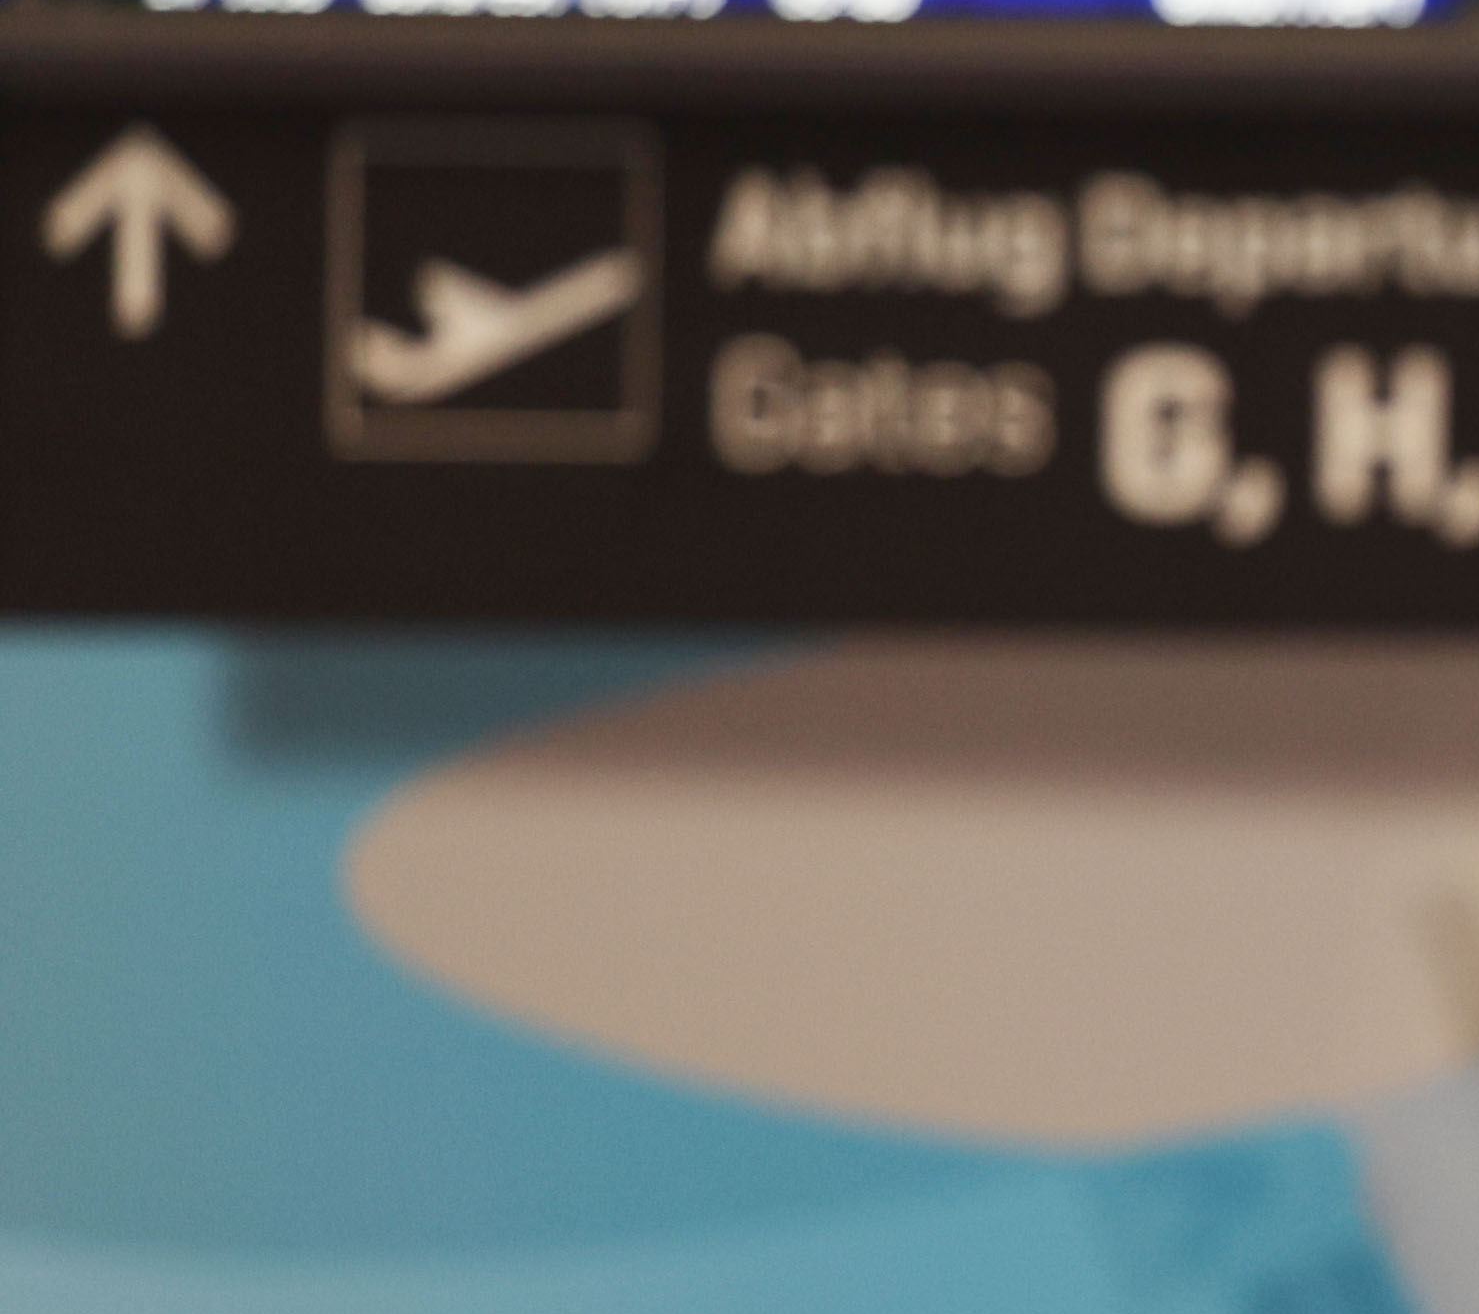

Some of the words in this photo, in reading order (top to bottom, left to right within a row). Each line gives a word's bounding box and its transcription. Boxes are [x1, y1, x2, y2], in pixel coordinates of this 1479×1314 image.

[712, 173, 1067, 313] Abflug
[713, 340, 1054, 473] Gates
[1100, 345, 1284, 545] G,
